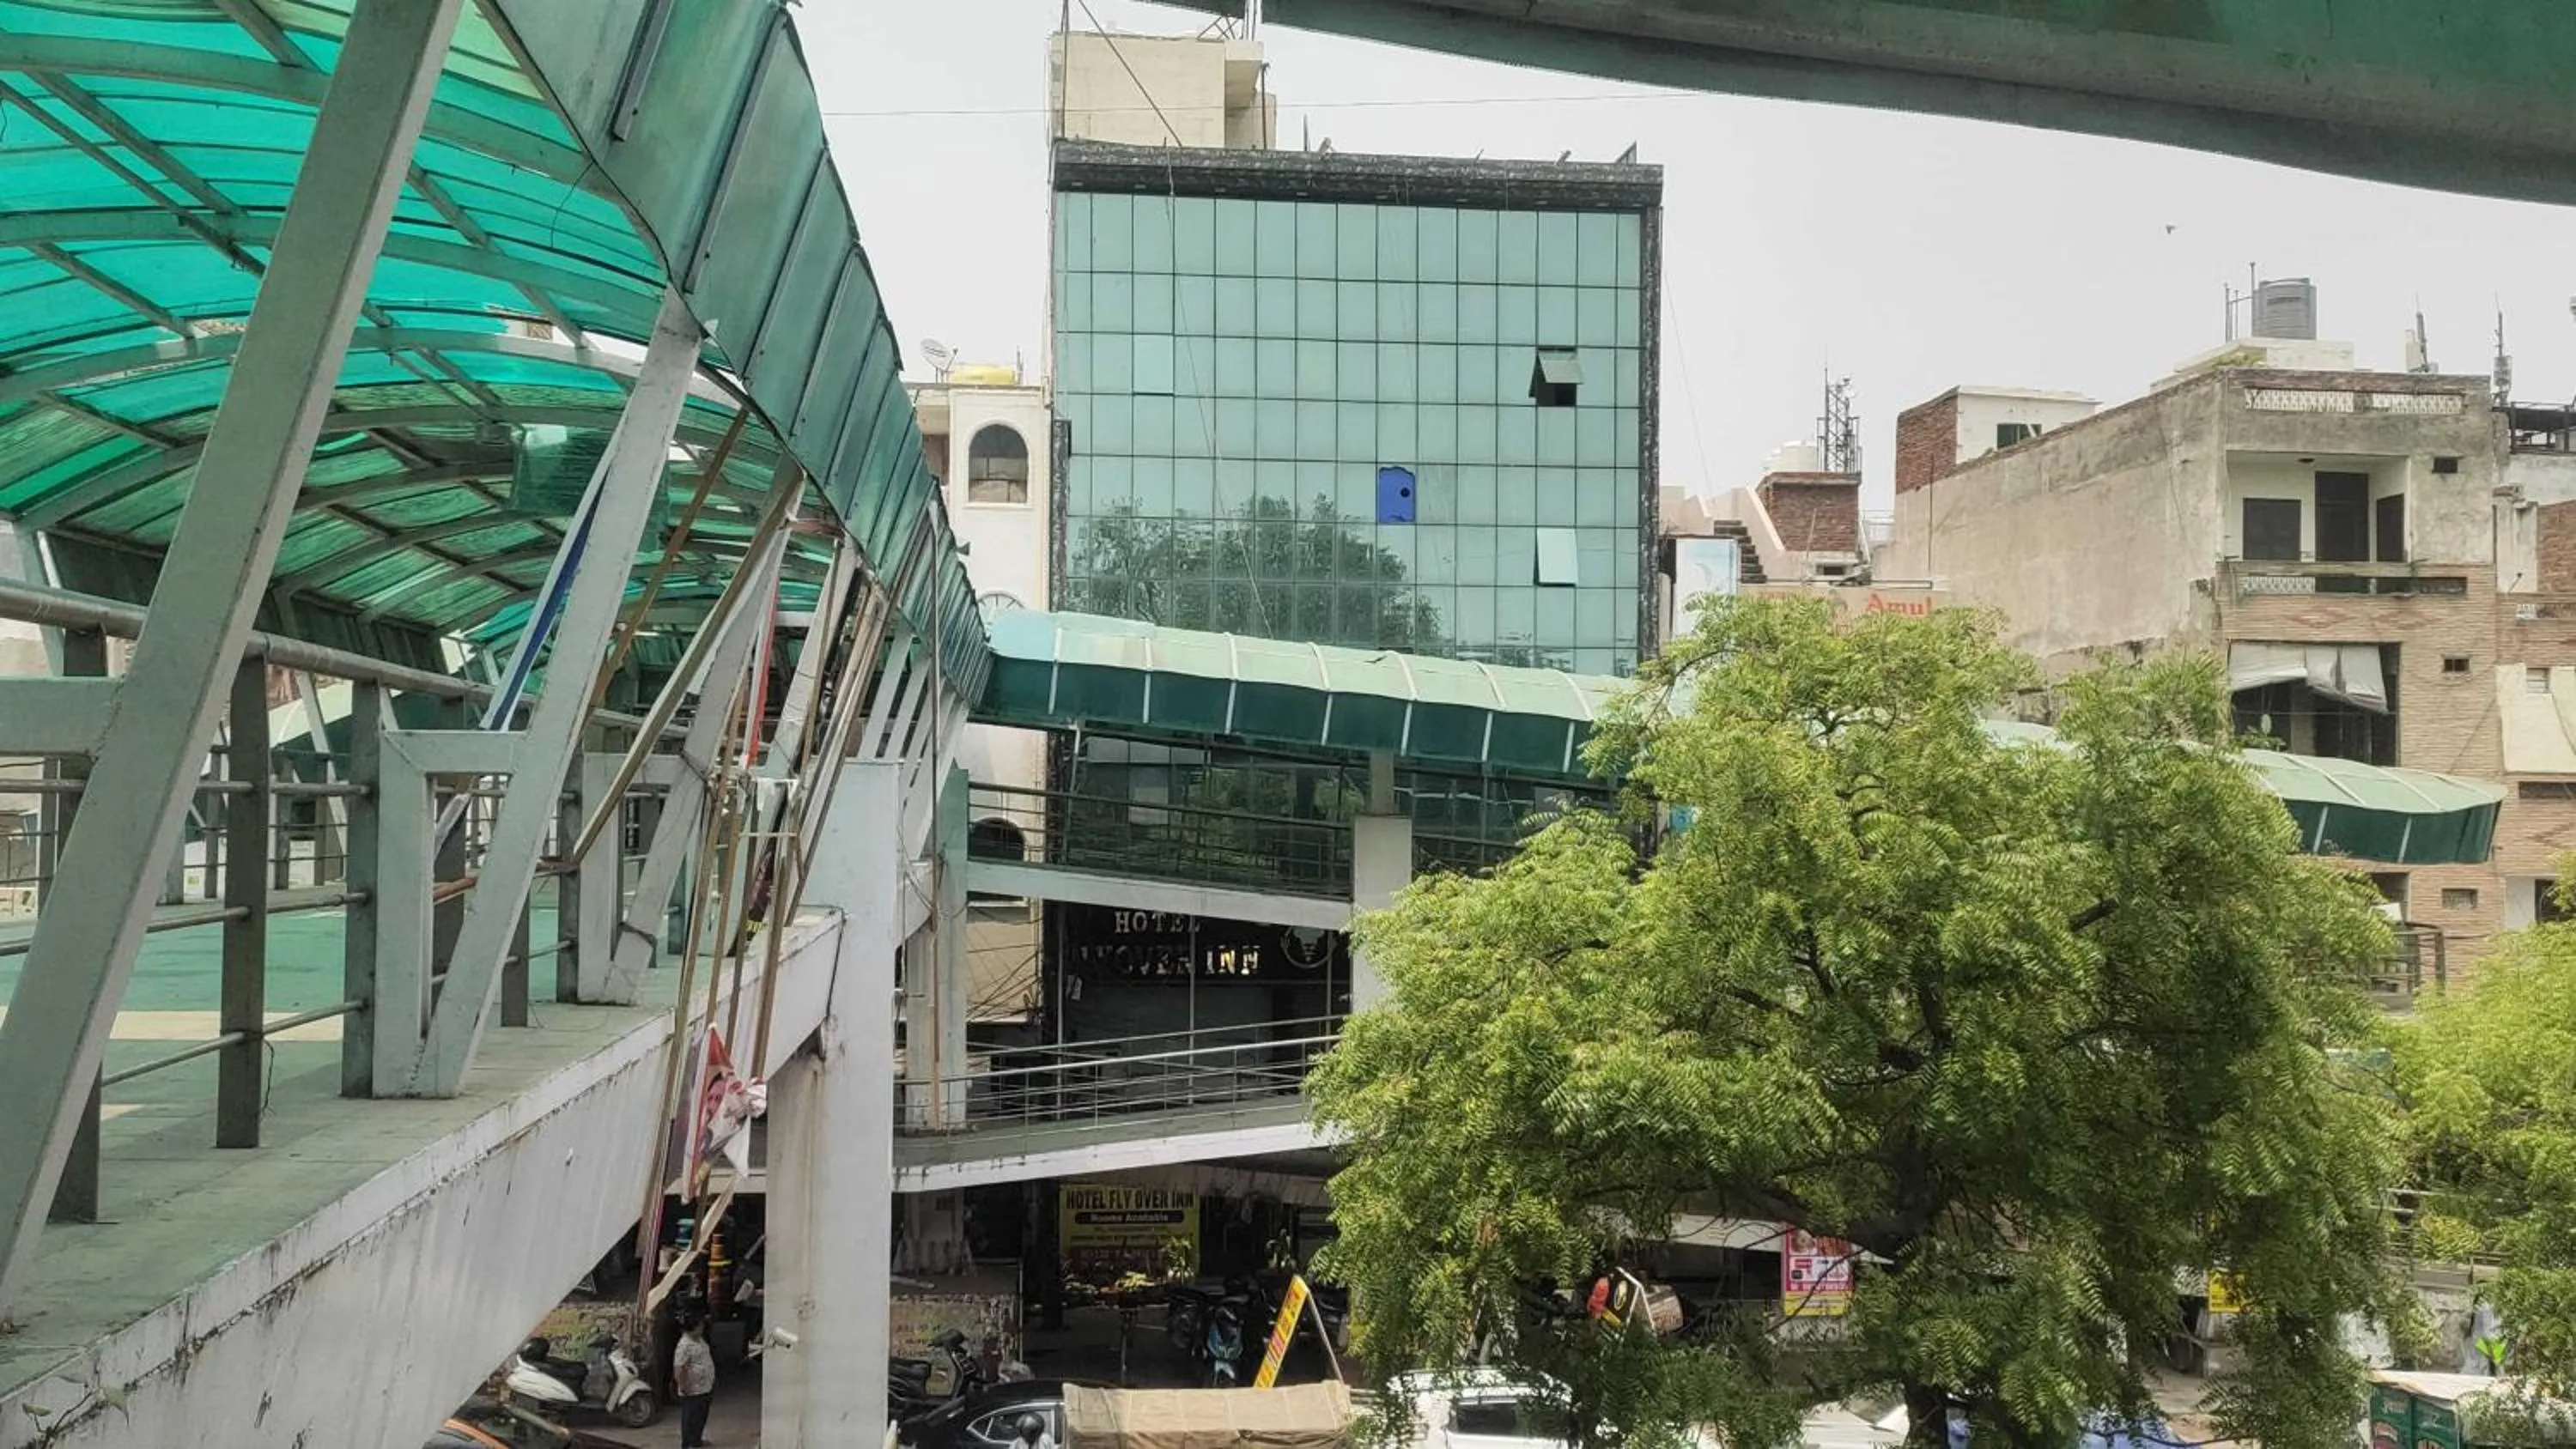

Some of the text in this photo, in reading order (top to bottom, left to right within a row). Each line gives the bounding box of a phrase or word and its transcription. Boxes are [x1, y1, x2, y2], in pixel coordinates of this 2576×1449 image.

[1865, 593, 1932, 616] Amul
[1114, 910, 1201, 934] HOTEL
[1205, 945, 1263, 975] INN
[1066, 1189, 1194, 1210] HOTEL FLY OVER INN
